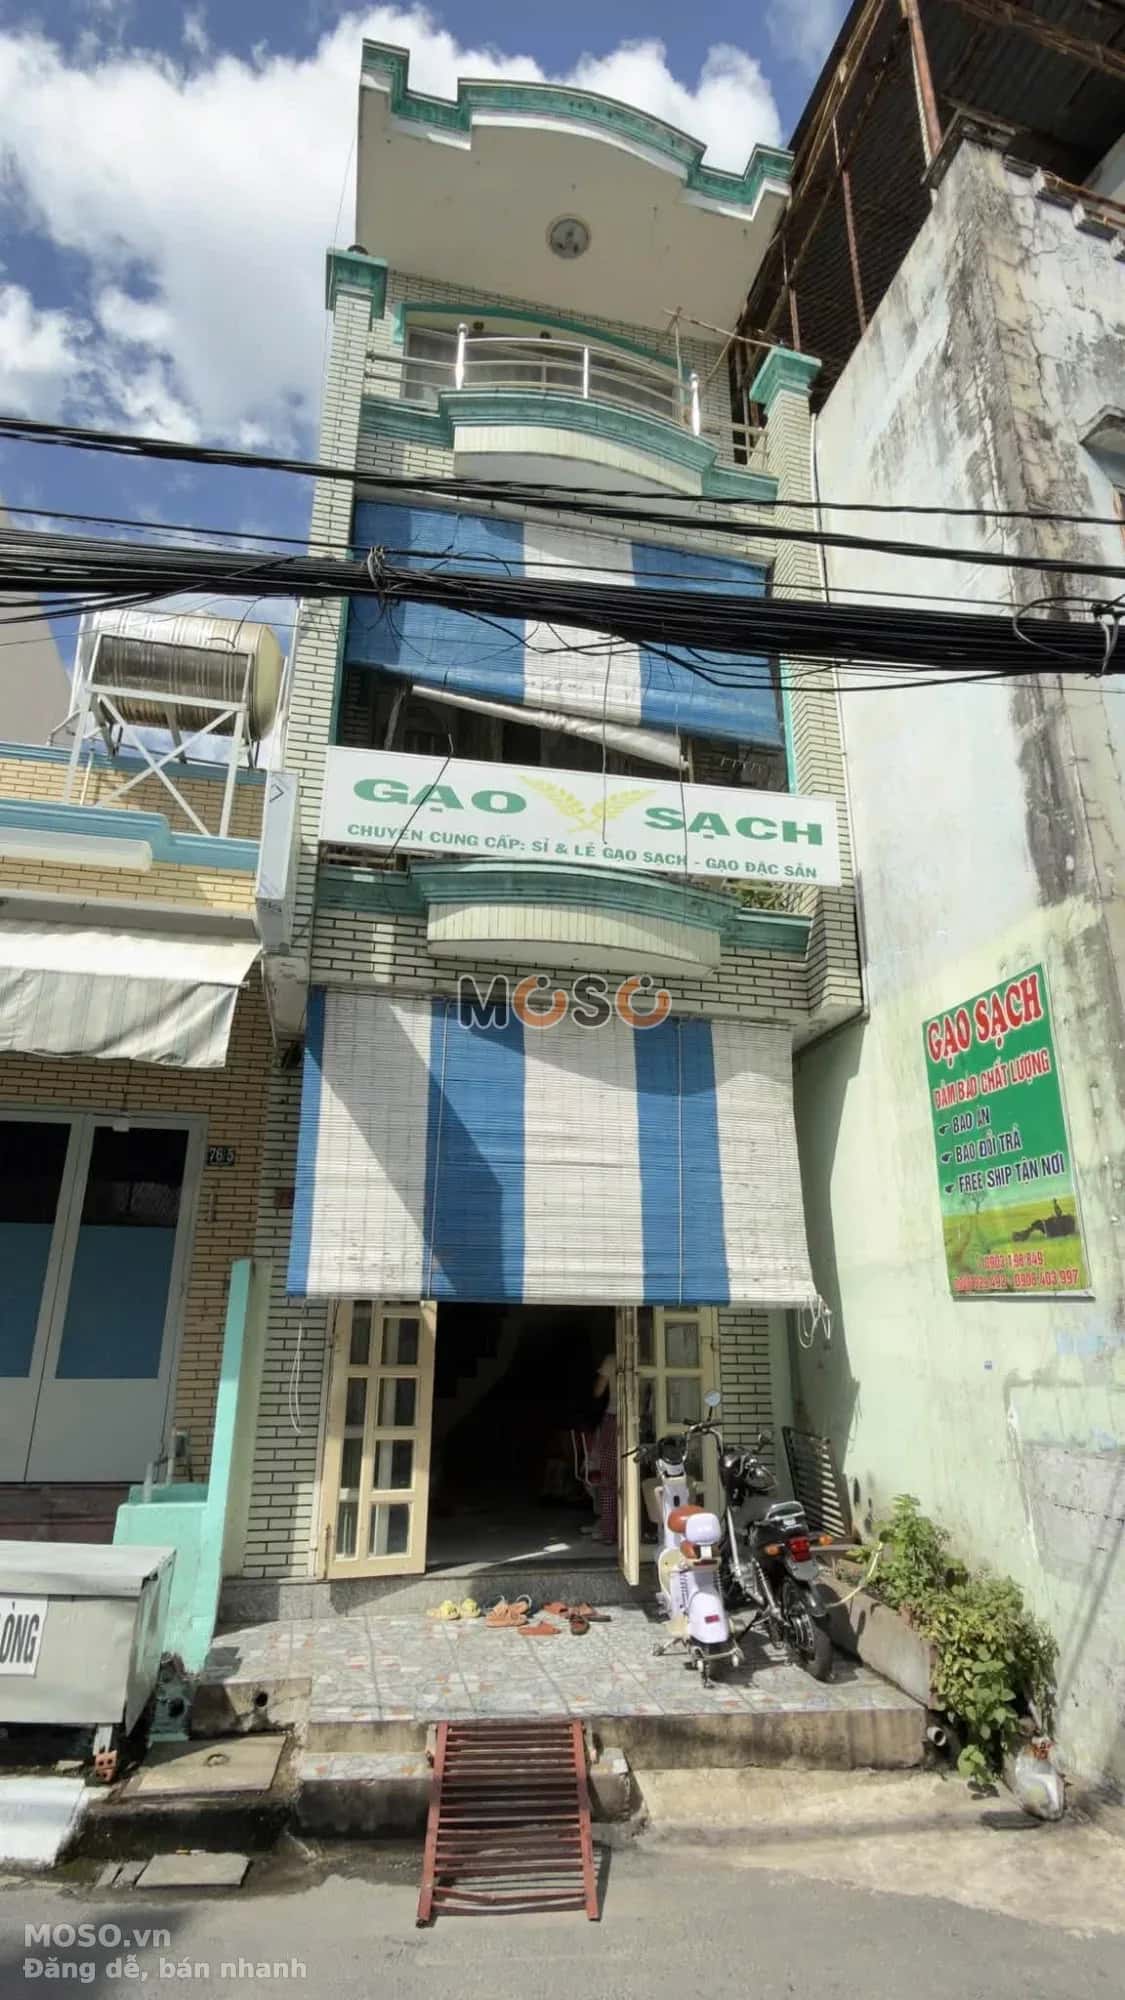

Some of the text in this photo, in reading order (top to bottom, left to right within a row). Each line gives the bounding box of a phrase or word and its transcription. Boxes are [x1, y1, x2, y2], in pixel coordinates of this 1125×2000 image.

[354, 778, 823, 846] GẠO SẠCH
[430, 831, 479, 847] CUNG
[484, 832, 526, 851] CẤP:
[532, 837, 550, 853] SỈ
[555, 843, 568, 855] &
[574, 841, 596, 858] LẺ
[602, 846, 637, 863] GẠO
[643, 850, 688, 867] SẠCH
[705, 857, 739, 874] GẠO
[745, 861, 779, 877] ĐẶC
[784, 861, 817, 879] SẢN
[928, 972, 1043, 1069] GẠO SẠCH
[980, 1056, 1008, 1095] CHẤT
[1009, 1048, 1050, 1085] LƯỢNG
[953, 1112, 973, 1133] BAO
[956, 1122, 1022, 1163] BAO ĐỔI TRẢ
[959, 1151, 1065, 1192] FREE SHIP TẬN NƠI
[1060, 1268, 1079, 1285] 997
[0, 1601, 40, 1664] ÒNG
